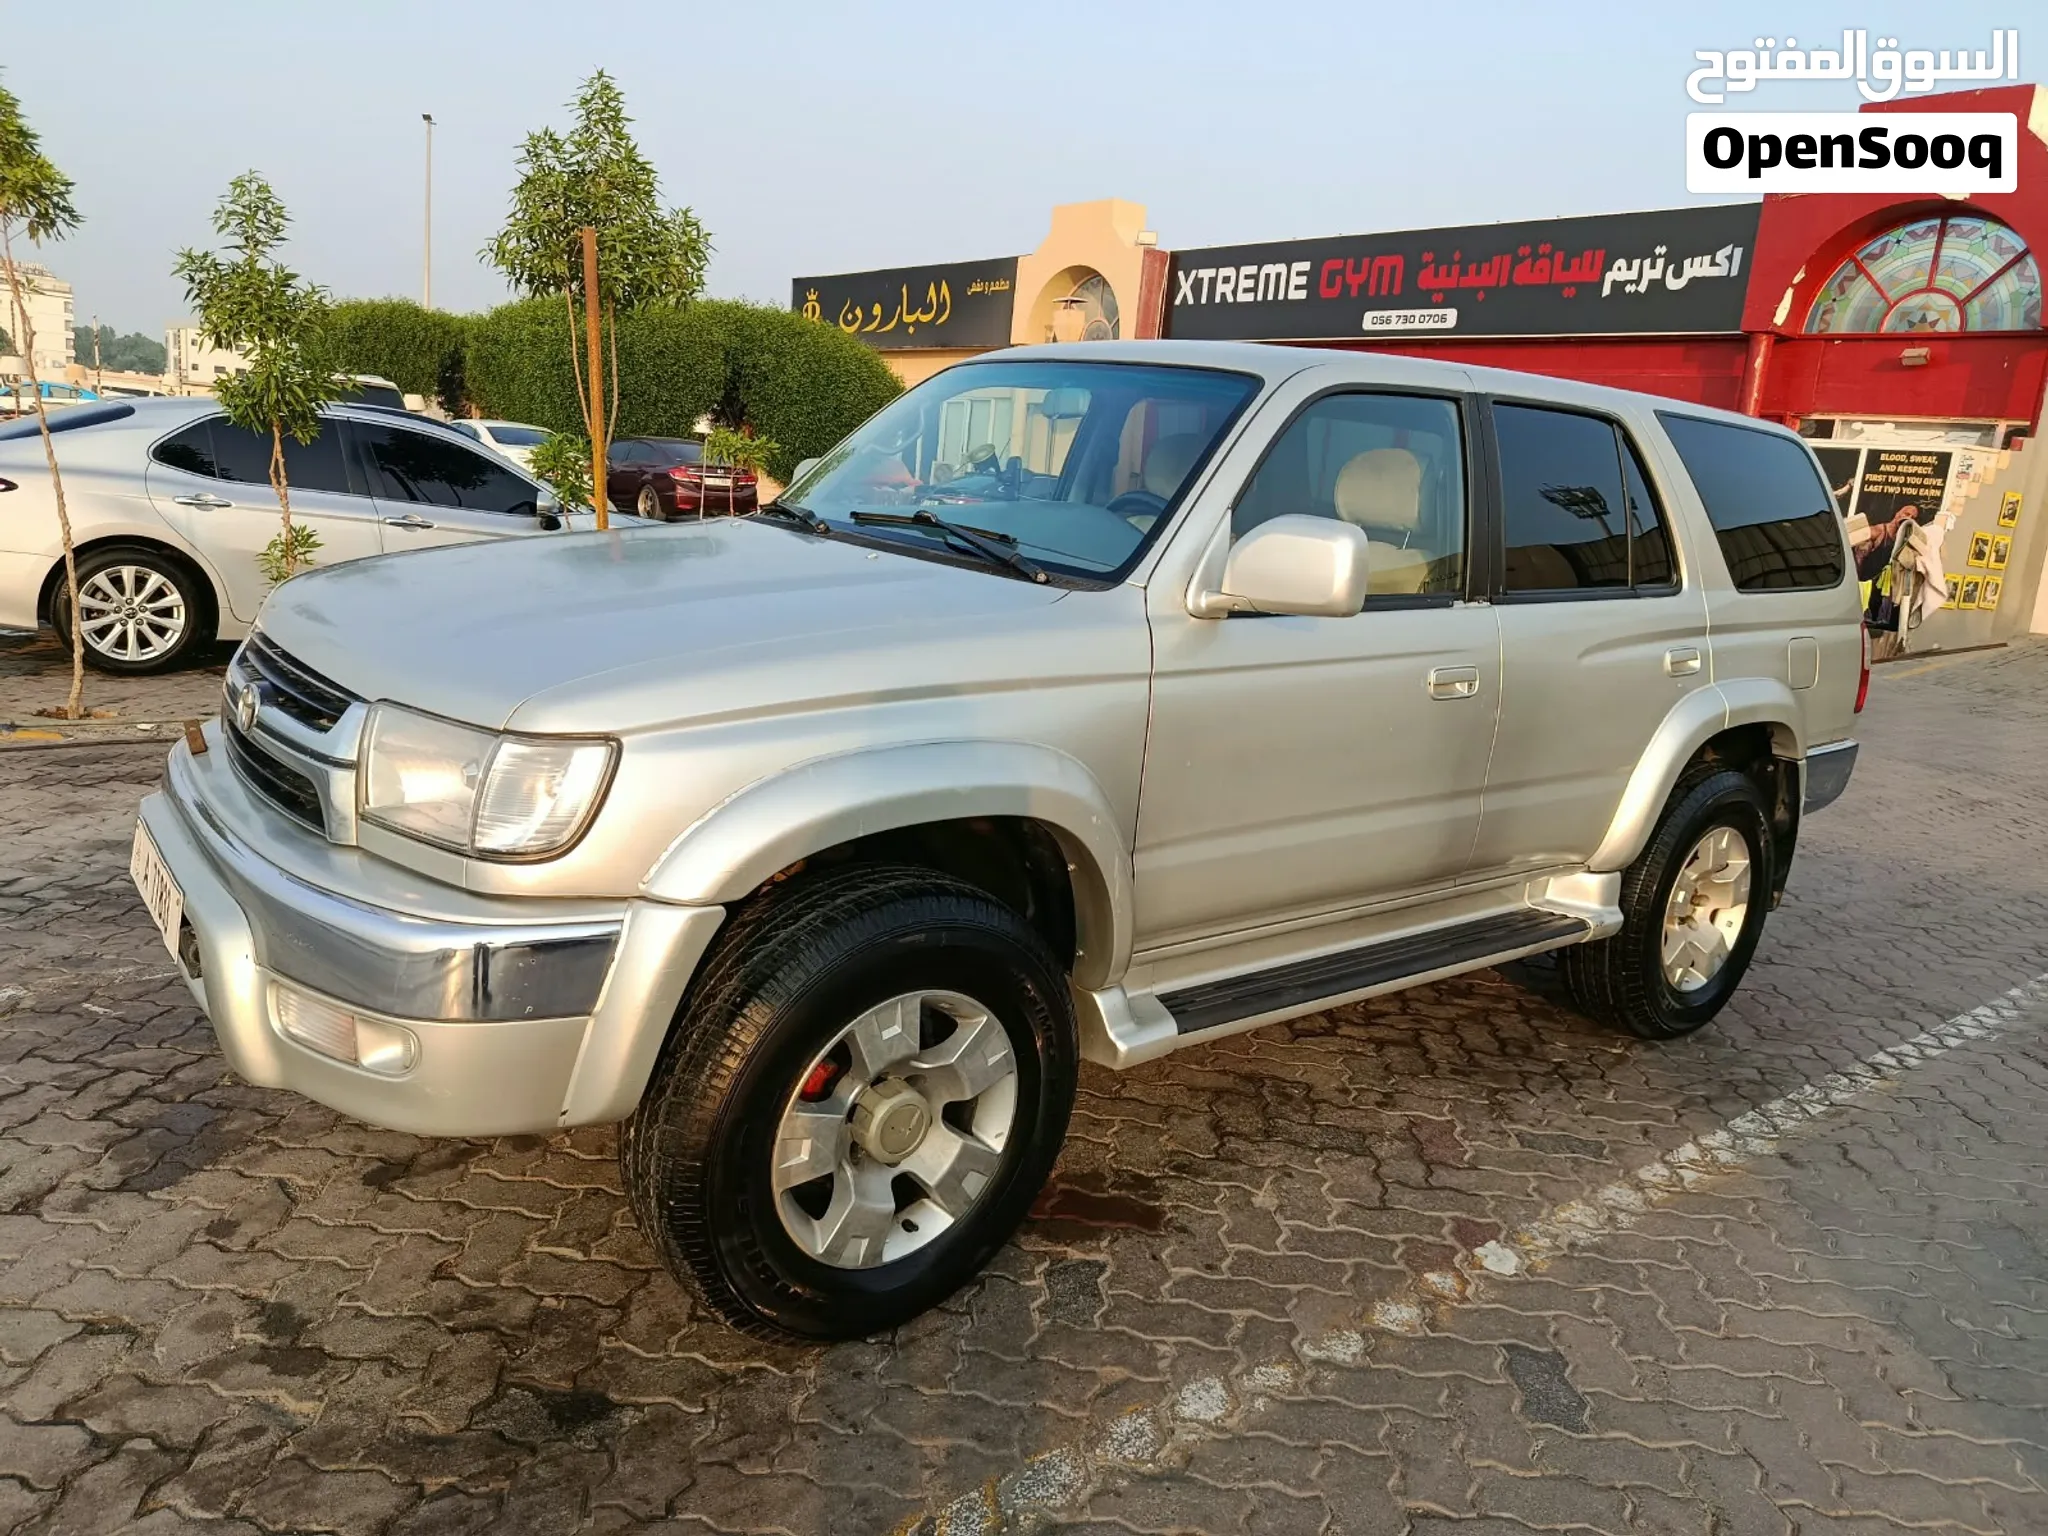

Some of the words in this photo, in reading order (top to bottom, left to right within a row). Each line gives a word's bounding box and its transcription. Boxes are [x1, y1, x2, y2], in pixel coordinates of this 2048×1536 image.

[1417, 250, 1513, 303] البدنية
[1513, 242, 1606, 298] للياقة
[1174, 261, 1311, 306] XTREME
[1319, 254, 1404, 299] GYM
[839, 279, 951, 335] البارون
[1371, 315, 1392, 325] 056
[1395, 314, 1416, 325] 730
[1418, 313, 1448, 324] 0706
[1880, 453, 1908, 463] BLOOD,
[1909, 454, 1938, 465] SWEAT,
[1879, 464, 1896, 472] AND
[1897, 465, 1934, 474] RESPECT.
[1865, 473, 1887, 482] FIRST
[1888, 474, 1905, 484] TWO
[1906, 476, 1923, 485] YOU
[1863, 484, 1883, 492] LAST
[1884, 485, 1901, 494] TWO
[1902, 486, 1919, 495] YOU
[1919, 488, 1942, 497] EARN
